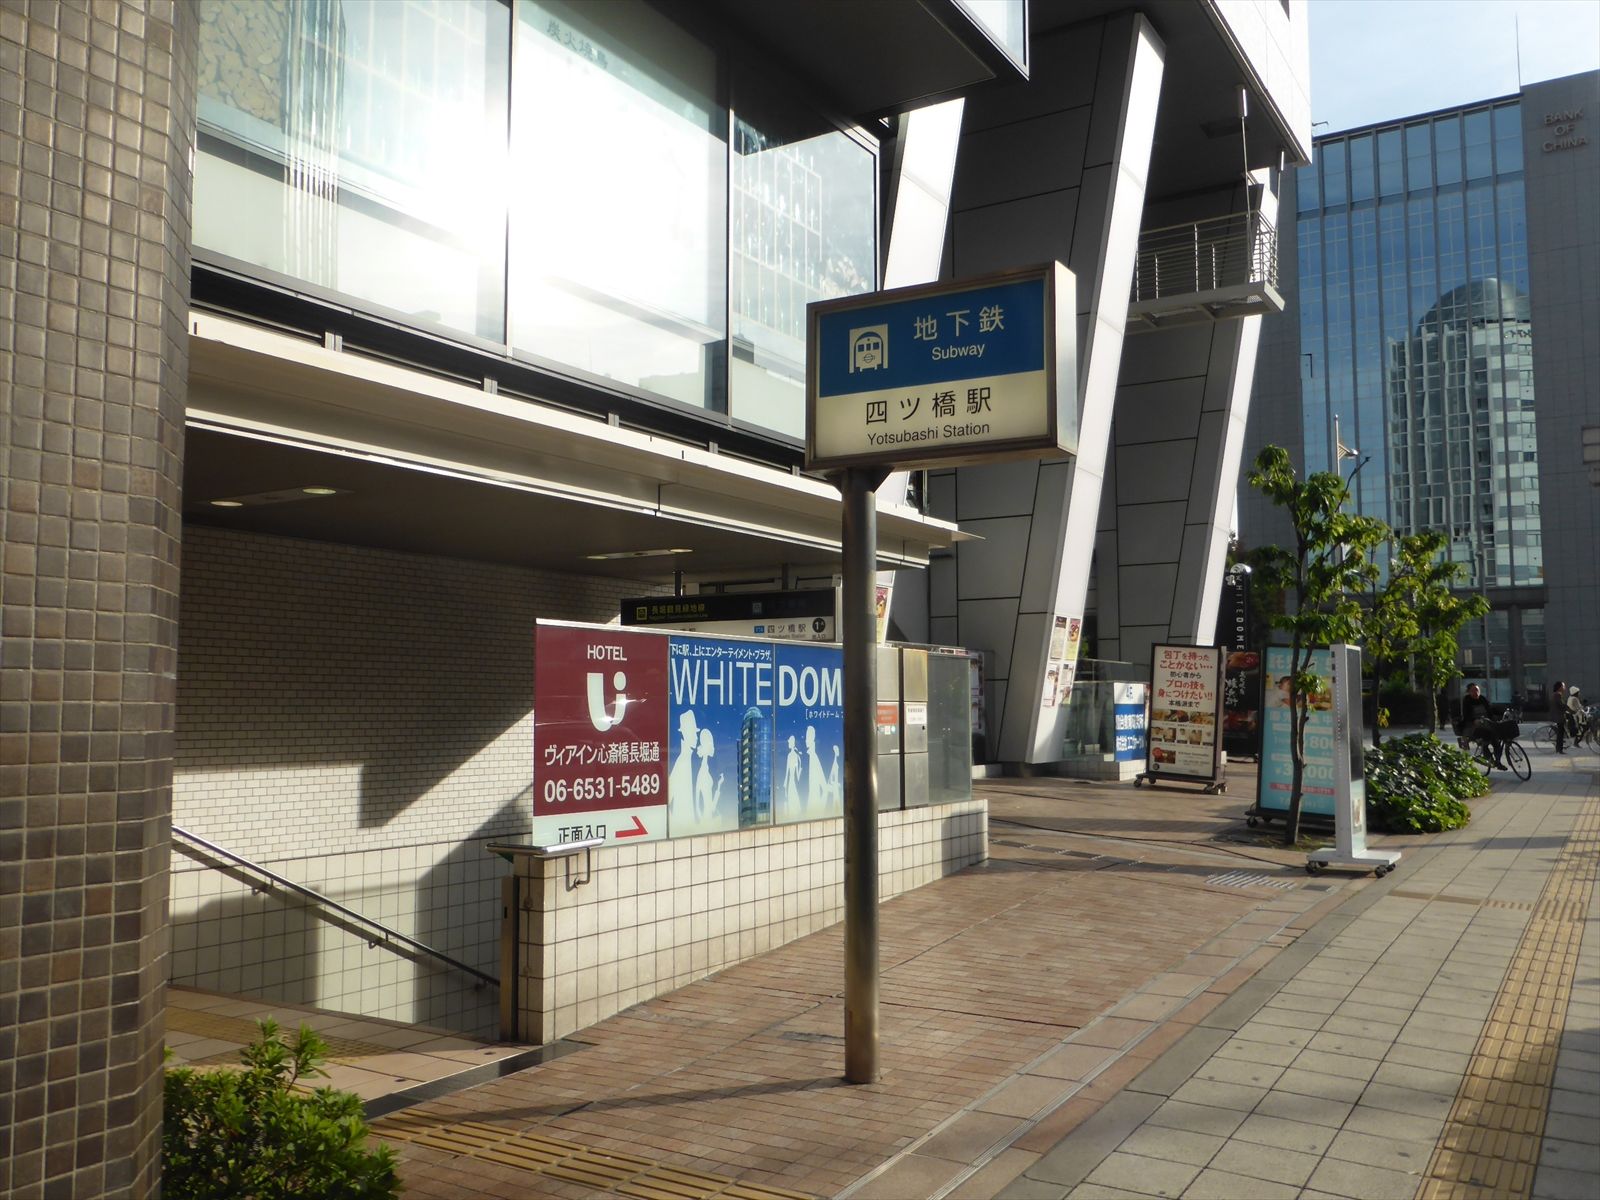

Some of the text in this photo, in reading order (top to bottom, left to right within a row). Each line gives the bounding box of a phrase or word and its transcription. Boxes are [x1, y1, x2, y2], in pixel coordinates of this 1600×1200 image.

[1543, 108, 1584, 125] BANK
[1554, 124, 1575, 137] OF
[1542, 137, 1589, 153] CHINA
[913, 304, 1005, 341] 地下鉄
[931, 343, 985, 361] Subway
[865, 387, 992, 426] 四ツ橋駅
[867, 422, 990, 446] Yotsubashi Station
[767, 623, 806, 634] 四ツ橋駅
[587, 644, 627, 662] HOTEL
[1164, 650, 1210, 661] 包丁を持った
[671, 658, 772, 706] WHITE
[1170, 671, 1202, 679] 初心者から
[1166, 679, 1205, 690] プロの技を
[1169, 699, 1200, 708] 本格派まで
[805, 708, 844, 720] [ホワイトドーム
[545, 741, 660, 766] ヴィアイン心斎橋長堀通
[544, 773, 660, 802] 06-6531-5489
[558, 824, 606, 843] 正面入口
